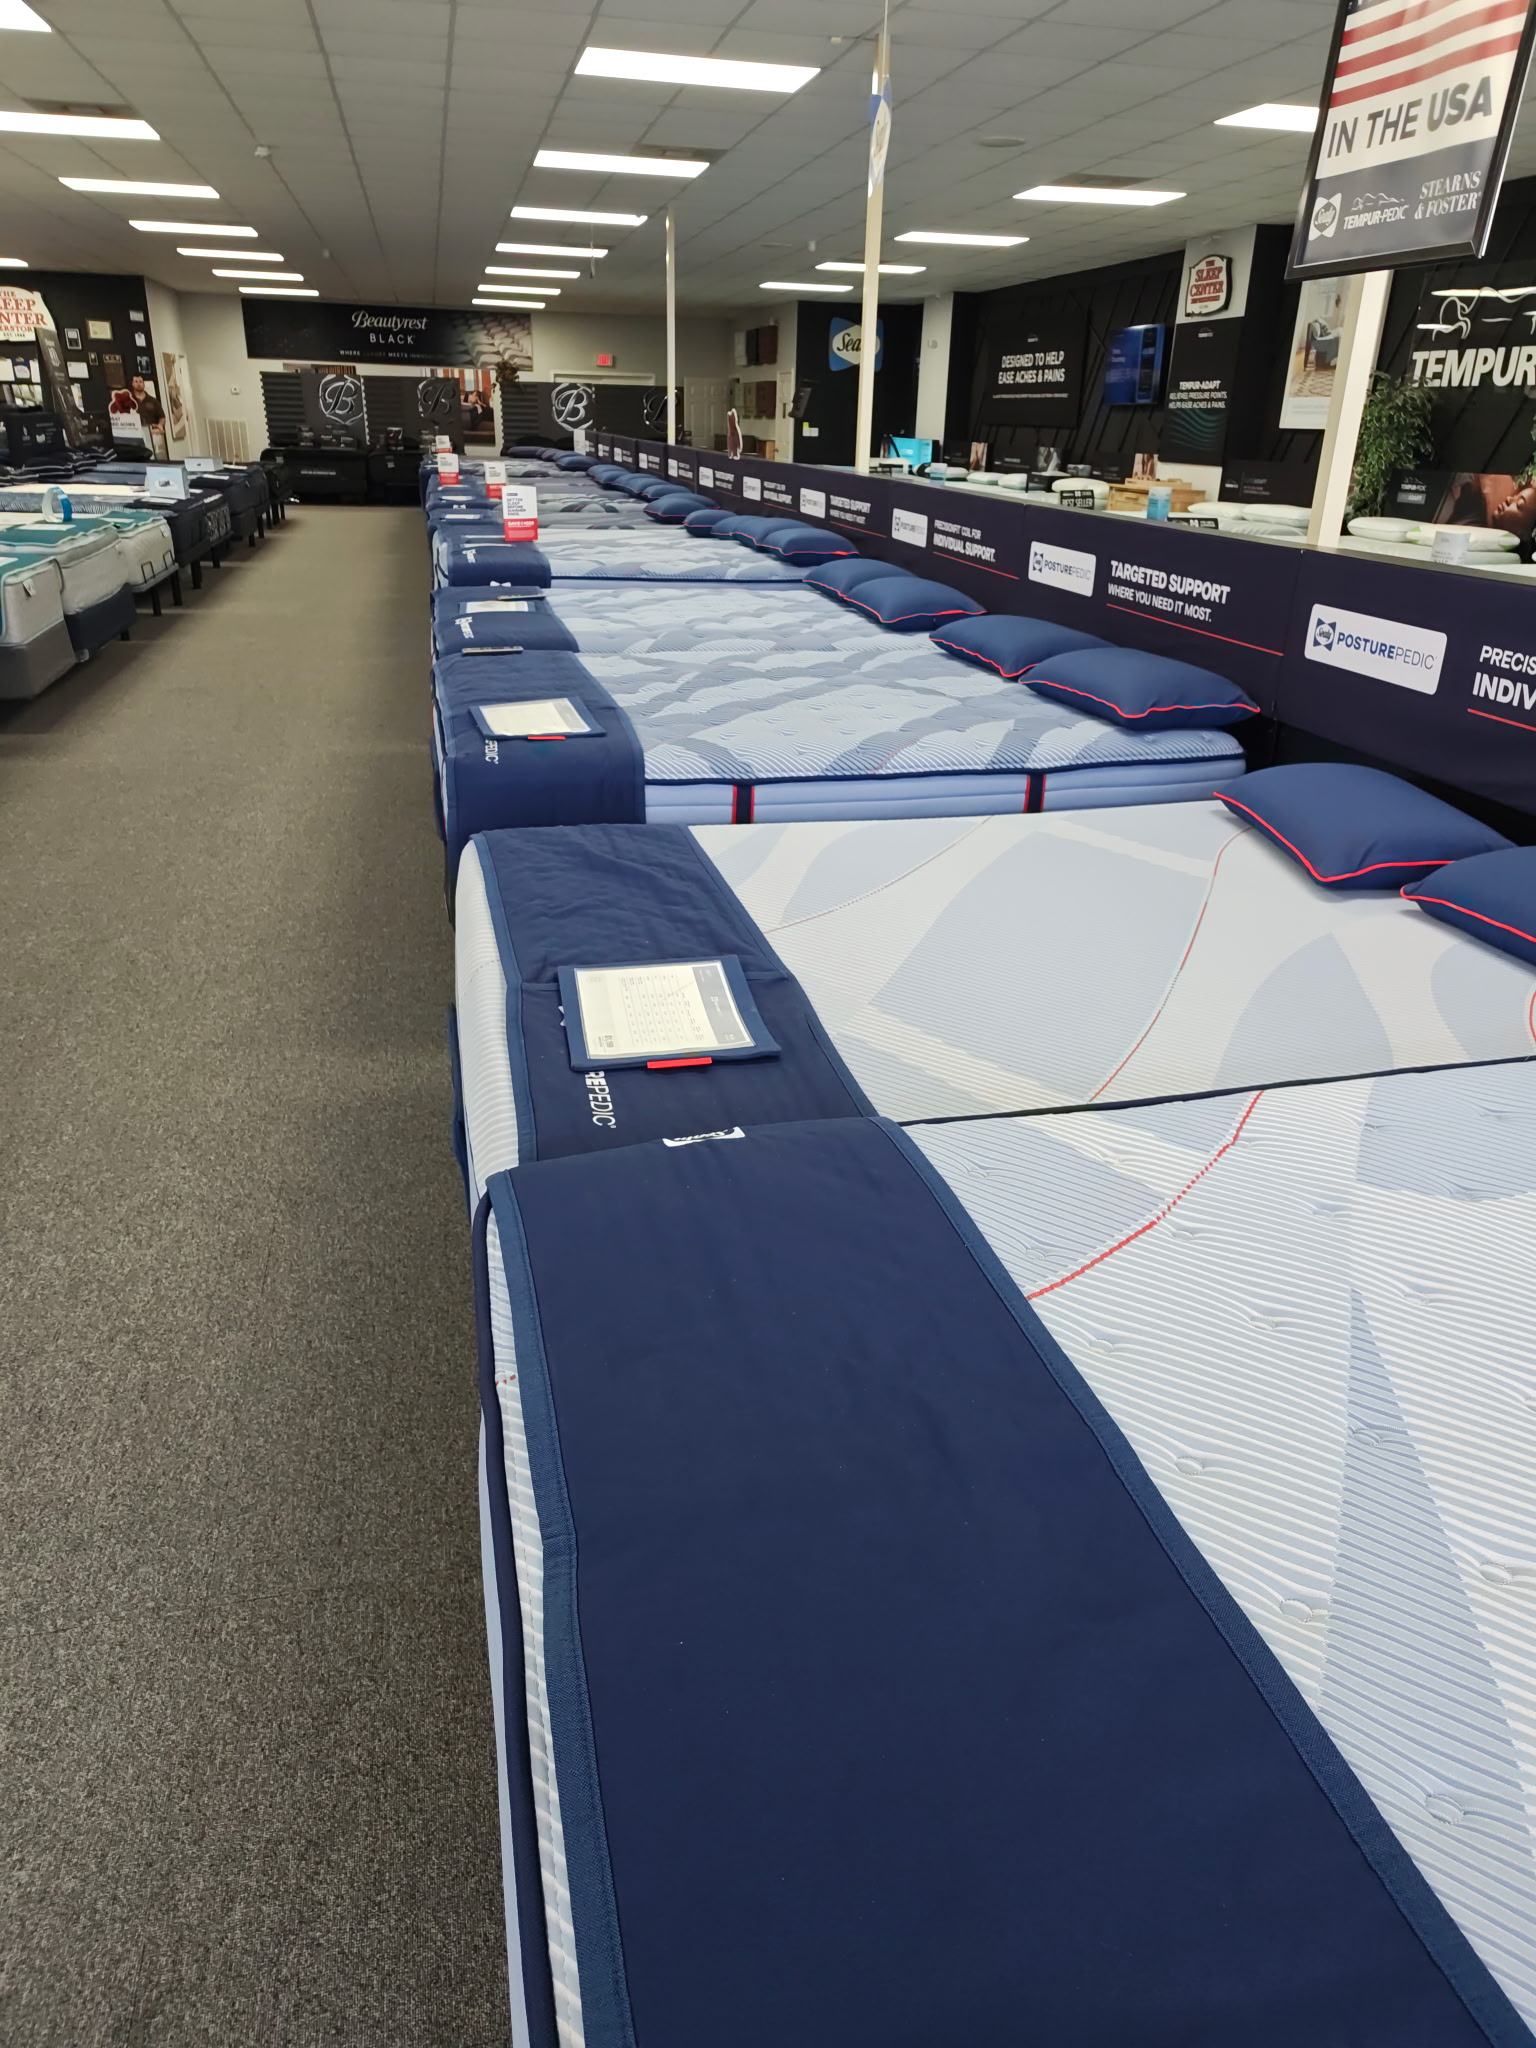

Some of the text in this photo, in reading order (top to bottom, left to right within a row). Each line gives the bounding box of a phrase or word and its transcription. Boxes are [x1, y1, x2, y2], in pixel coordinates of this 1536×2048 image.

[1327, 76, 1492, 158] IN THE USA
[1420, 171, 1481, 199] STEARNS
[1415, 192, 1477, 220] & FOSTER
[1343, 205, 1409, 230] TEMPUR-PEDIC
[1195, 266, 1223, 282] SLEEP
[1190, 280, 1224, 297] CENTER
[0, 298, 36, 311] EEP
[0, 312, 47, 326] NTER
[351, 310, 428, 331] Beautyrest
[369, 332, 414, 345] BLACK
[836, 332, 861, 352] Sea
[1001, 350, 1064, 368] DESIGNED TO HELP
[998, 371, 1015, 384] EASE
[1015, 369, 1037, 383] ACHES
[1043, 368, 1065, 382] PAINS
[933, 533, 964, 554] INDIVIDUAL
[1044, 559, 1092, 581] POSTUREPEDIC
[1110, 560, 1231, 605] TARGETED SUPPORT
[1107, 582, 1212, 622] WHERE YOU NEED IT MOST.
[1336, 631, 1436, 670] POSTUREPEDIC
